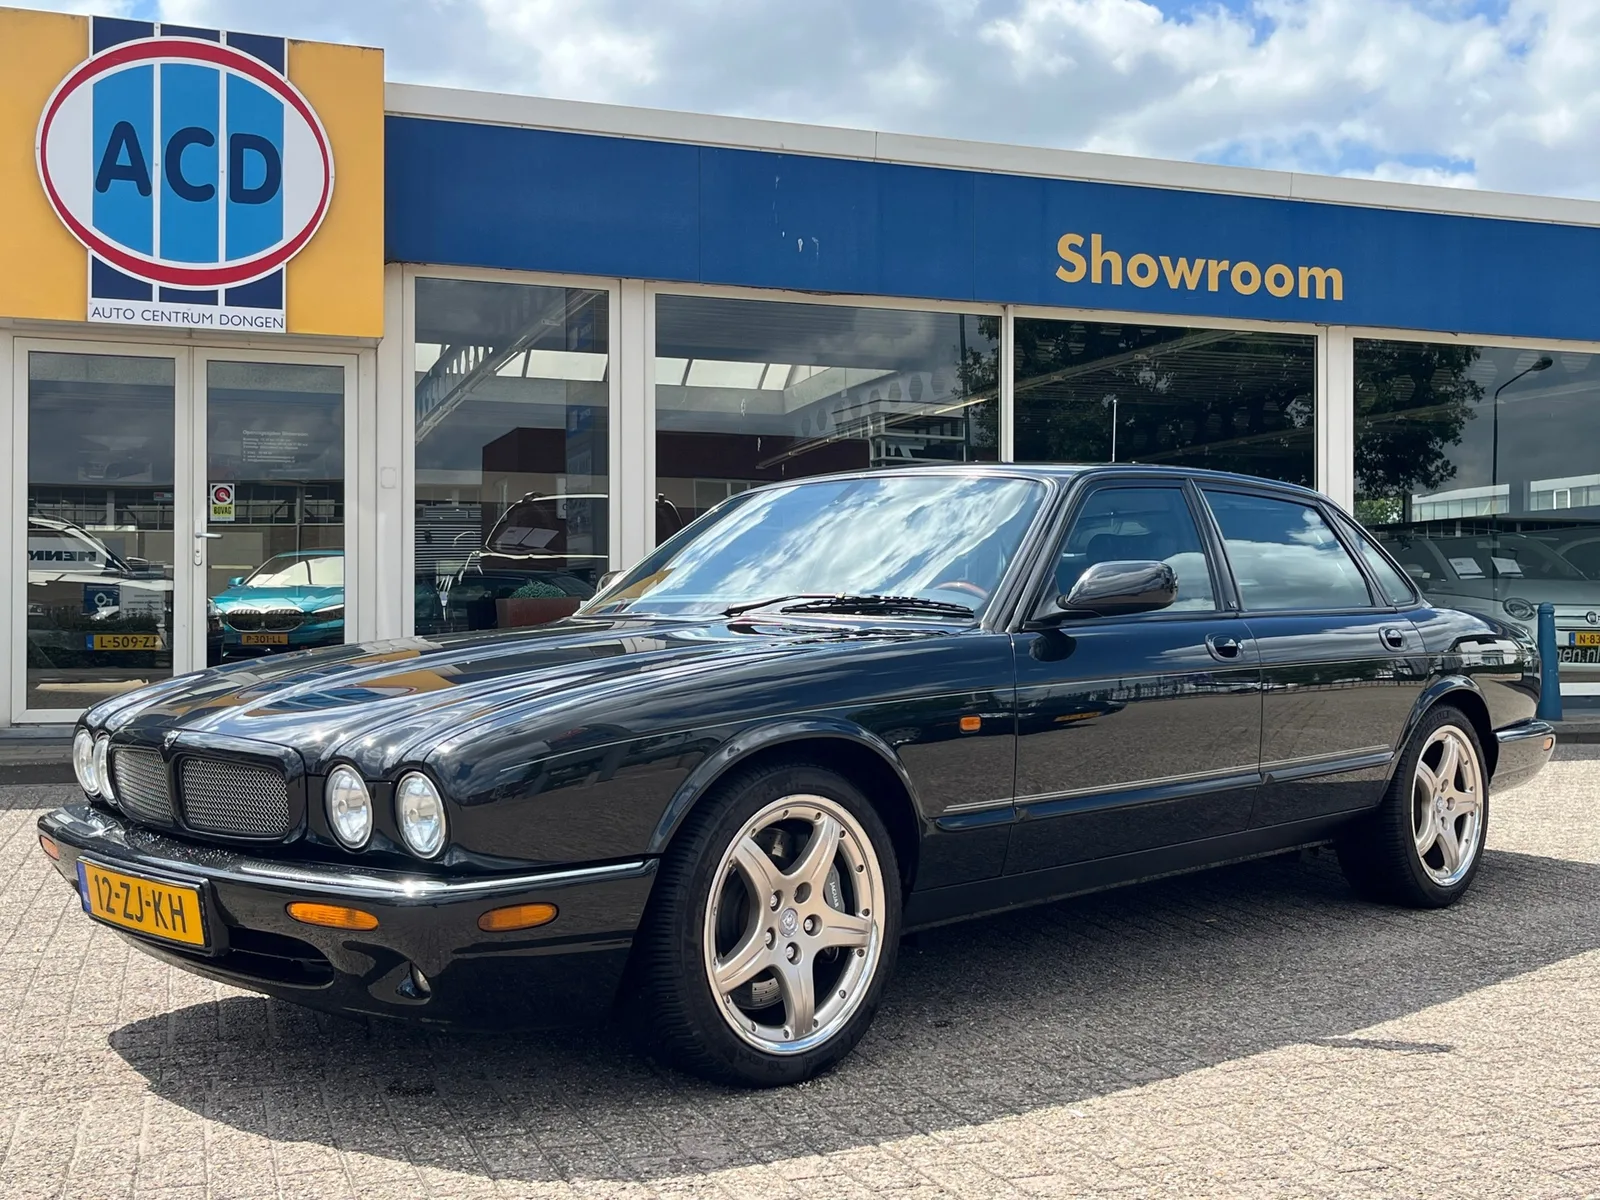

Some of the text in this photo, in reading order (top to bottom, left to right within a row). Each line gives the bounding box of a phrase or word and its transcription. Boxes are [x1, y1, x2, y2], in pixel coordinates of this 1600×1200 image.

[95, 121, 282, 205] ACD
[1056, 233, 1343, 300] Showroom
[91, 306, 284, 329] AUTO CENTRUM DONGEN
[213, 506, 232, 515] BOVAG
[94, 874, 187, 934] 12-ZJ-KH
[829, 881, 840, 908] JAGUAR
